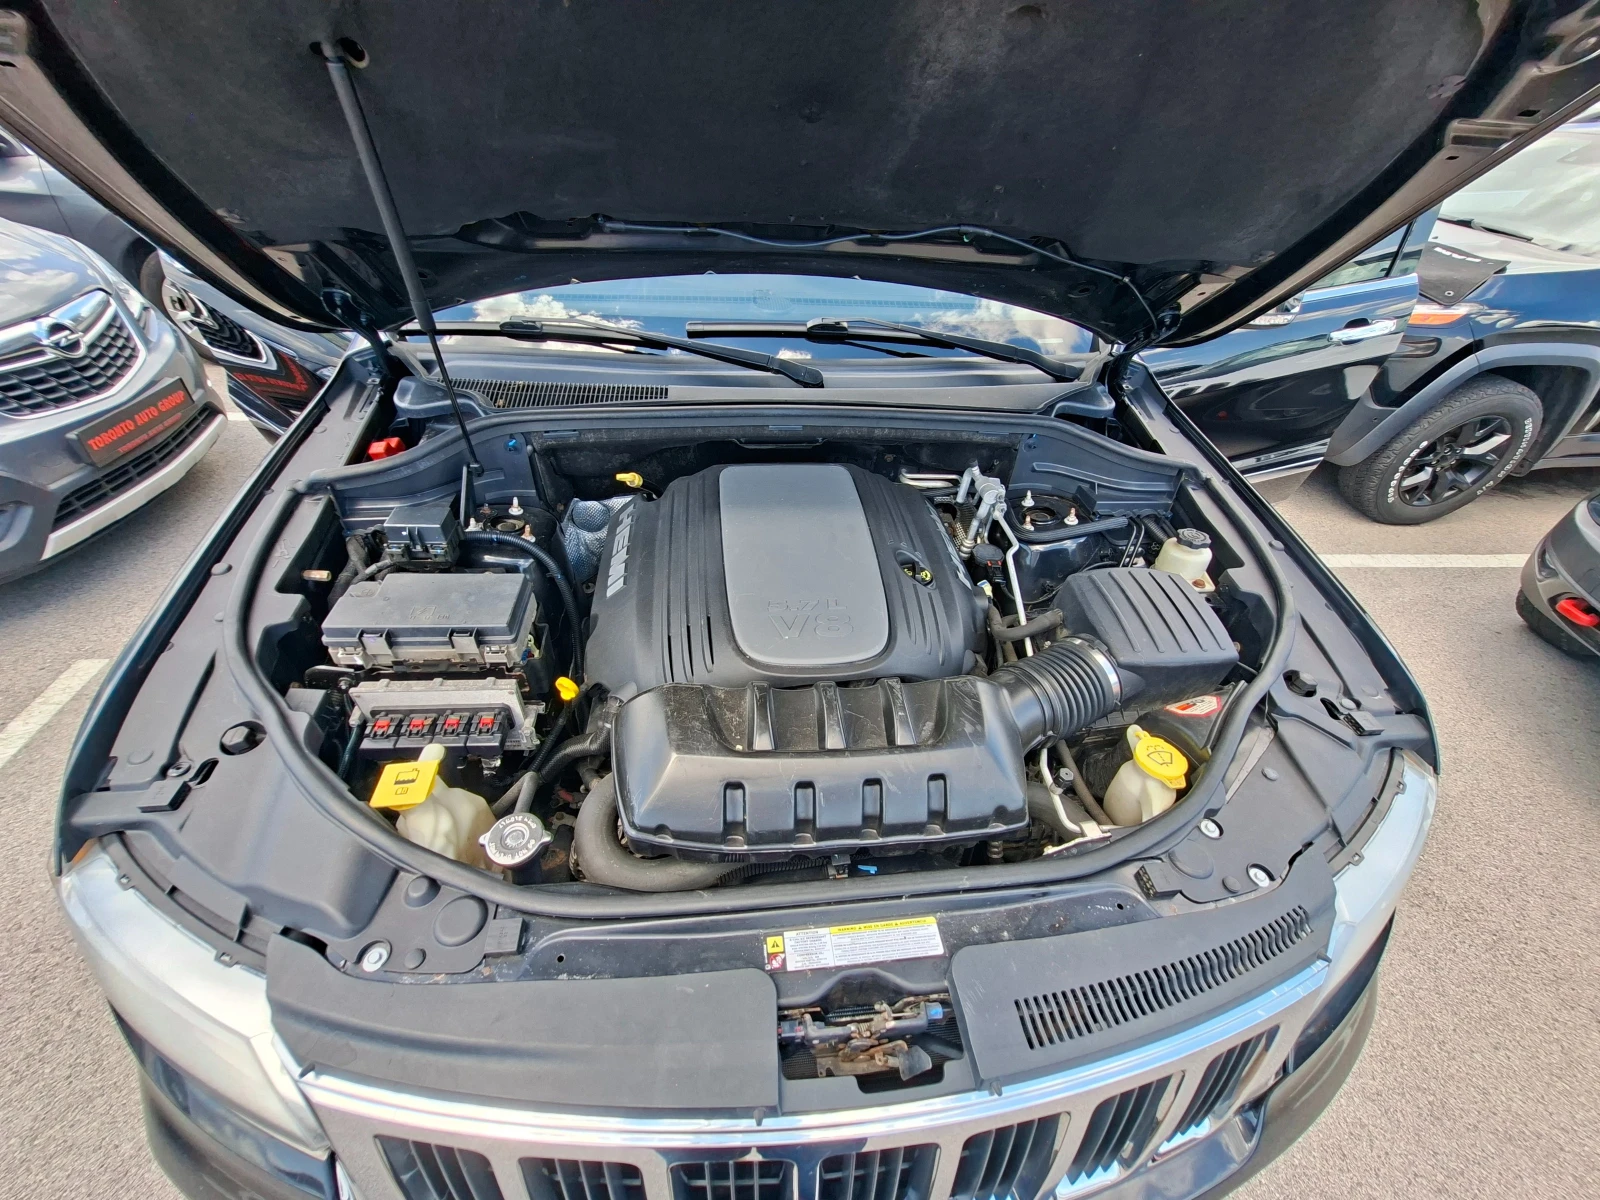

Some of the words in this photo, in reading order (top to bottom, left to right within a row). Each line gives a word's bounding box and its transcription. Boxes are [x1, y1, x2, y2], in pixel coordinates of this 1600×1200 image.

[87, 419, 136, 450] TORONTO
[134, 406, 159, 426] AUTO
[158, 390, 185, 411] GROUP
[606, 503, 635, 599] HEMI
[768, 613, 854, 638] V8
